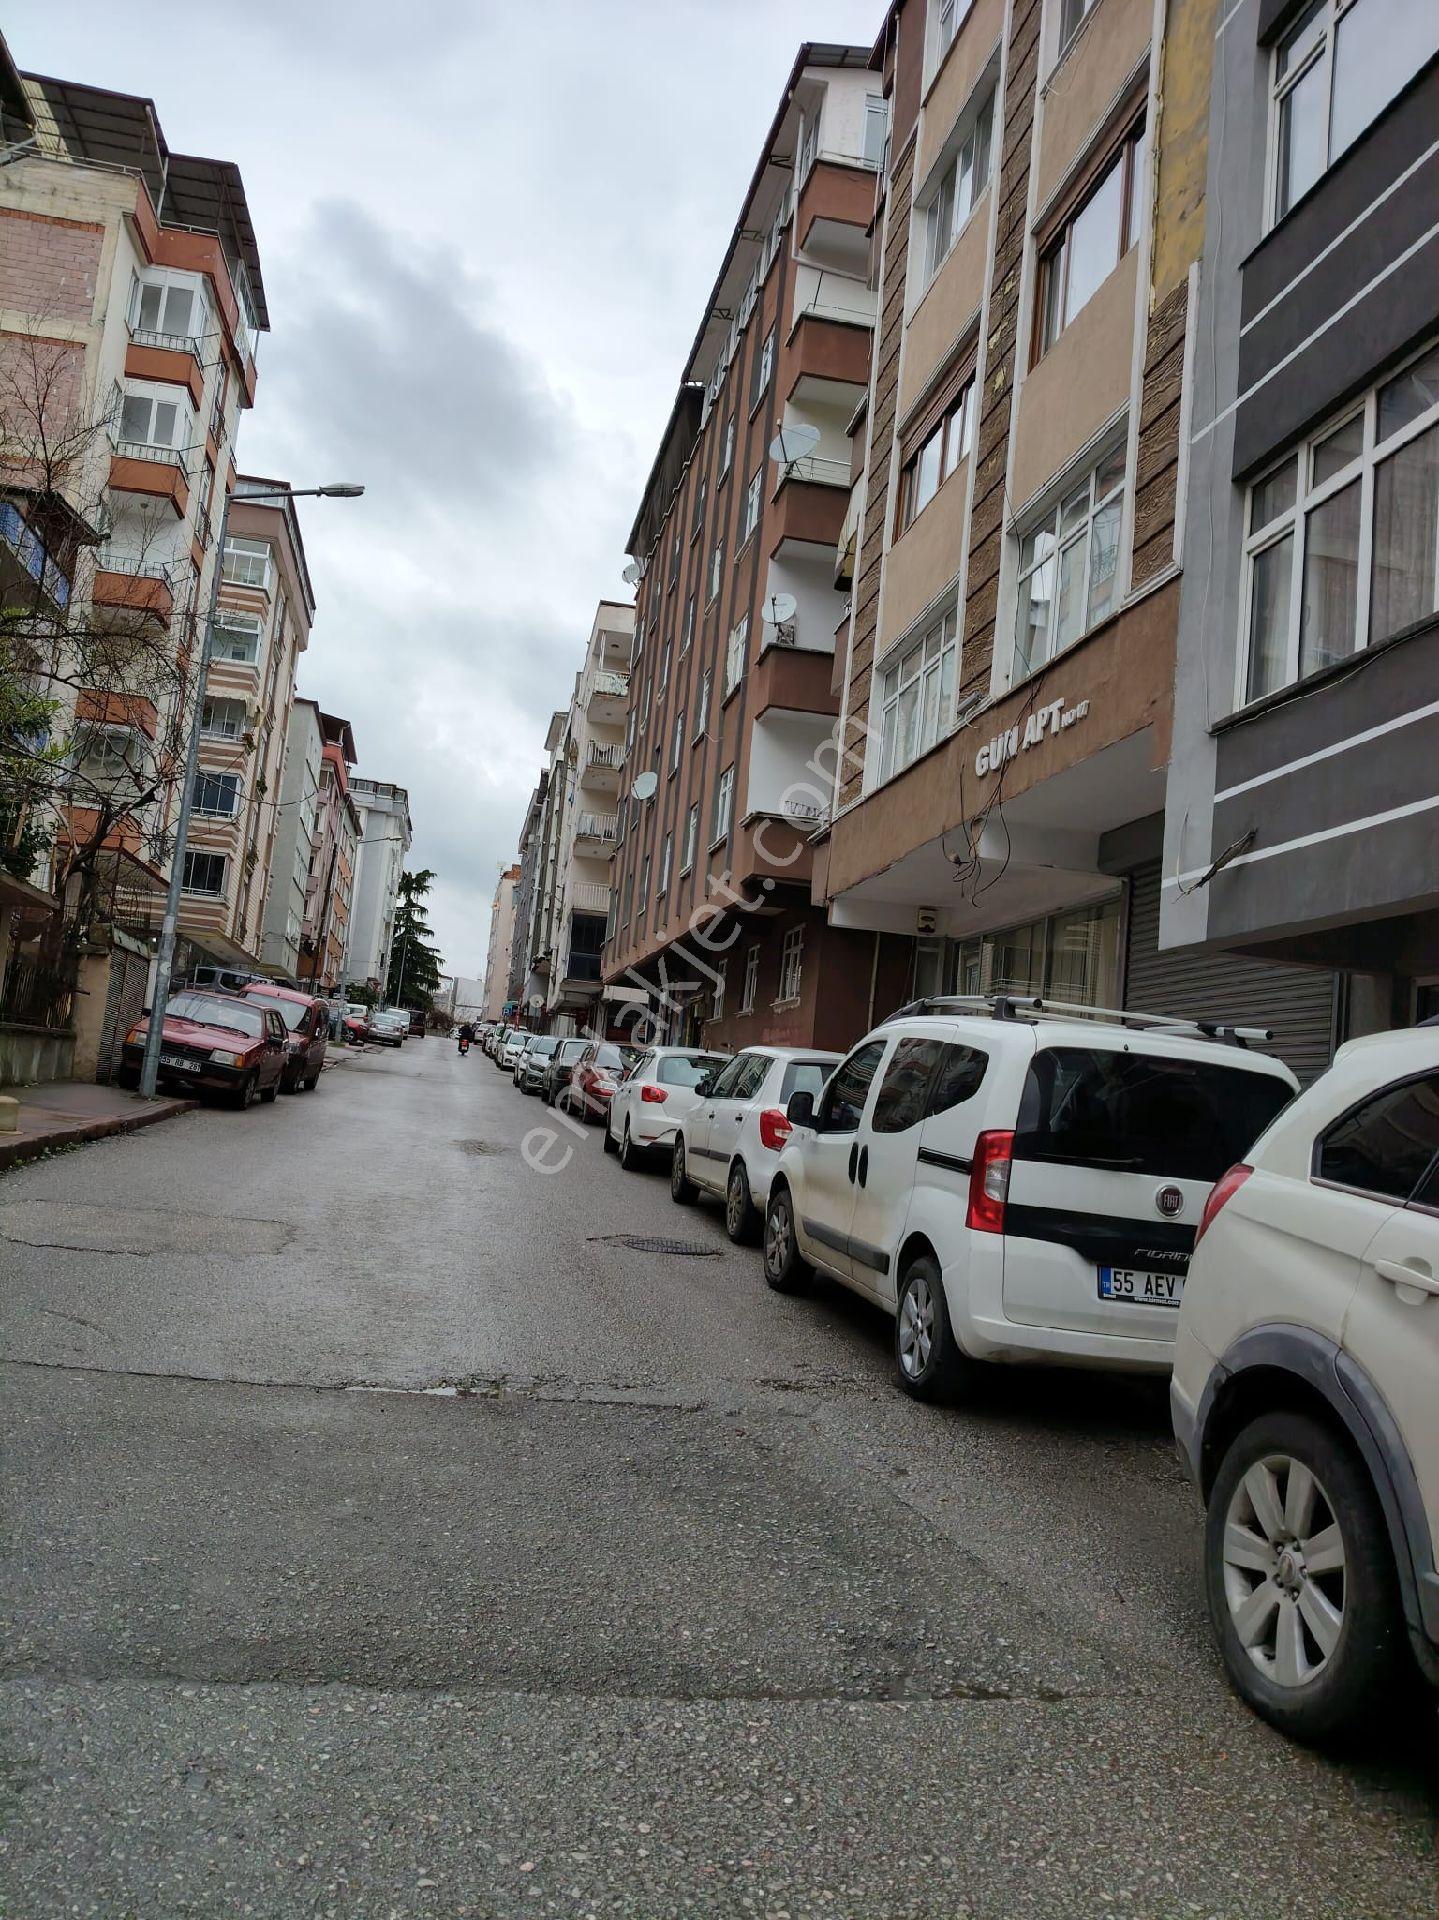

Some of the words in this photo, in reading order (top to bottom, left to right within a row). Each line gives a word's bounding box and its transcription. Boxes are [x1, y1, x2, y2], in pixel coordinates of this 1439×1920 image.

[1021, 696, 1066, 752] APT
[1163, 1194, 1179, 1208] FIAT
[1134, 1248, 1193, 1262] FIORIN
[1113, 1270, 1134, 1294] 55
[1144, 1274, 1176, 1298] AEV
